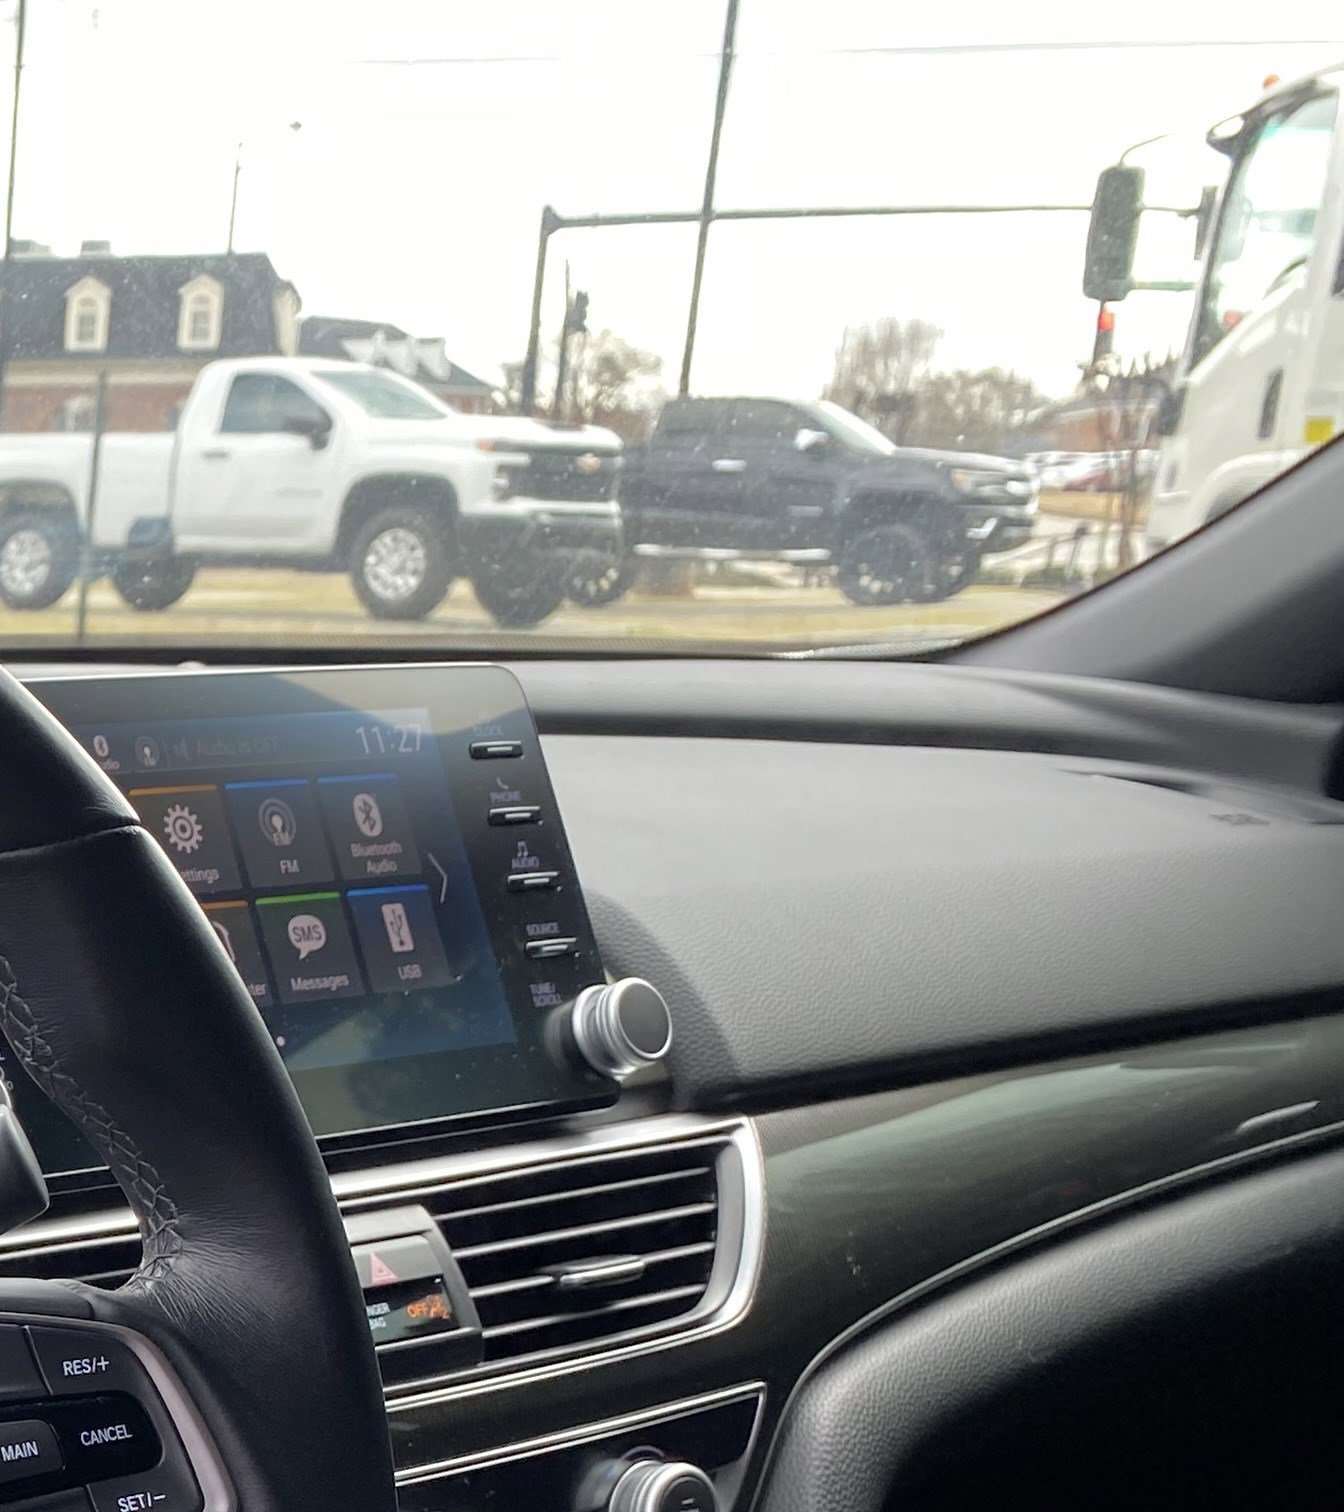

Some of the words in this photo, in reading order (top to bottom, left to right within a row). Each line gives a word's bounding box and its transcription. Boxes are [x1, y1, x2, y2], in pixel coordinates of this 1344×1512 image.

[355, 723, 422, 755] 11:27
[350, 842, 402, 859] Bluetooth
[184, 867, 219, 884] ettings
[280, 859, 299, 875] FM
[366, 859, 397, 875] Audio
[292, 925, 323, 944] SMS
[397, 964, 422, 980] USB
[291, 974, 350, 992] Messages
[62, 1356, 110, 1376] RES/+
[80, 1424, 133, 1447] CANCEL
[1, 1441, 39, 1462] MAIN
